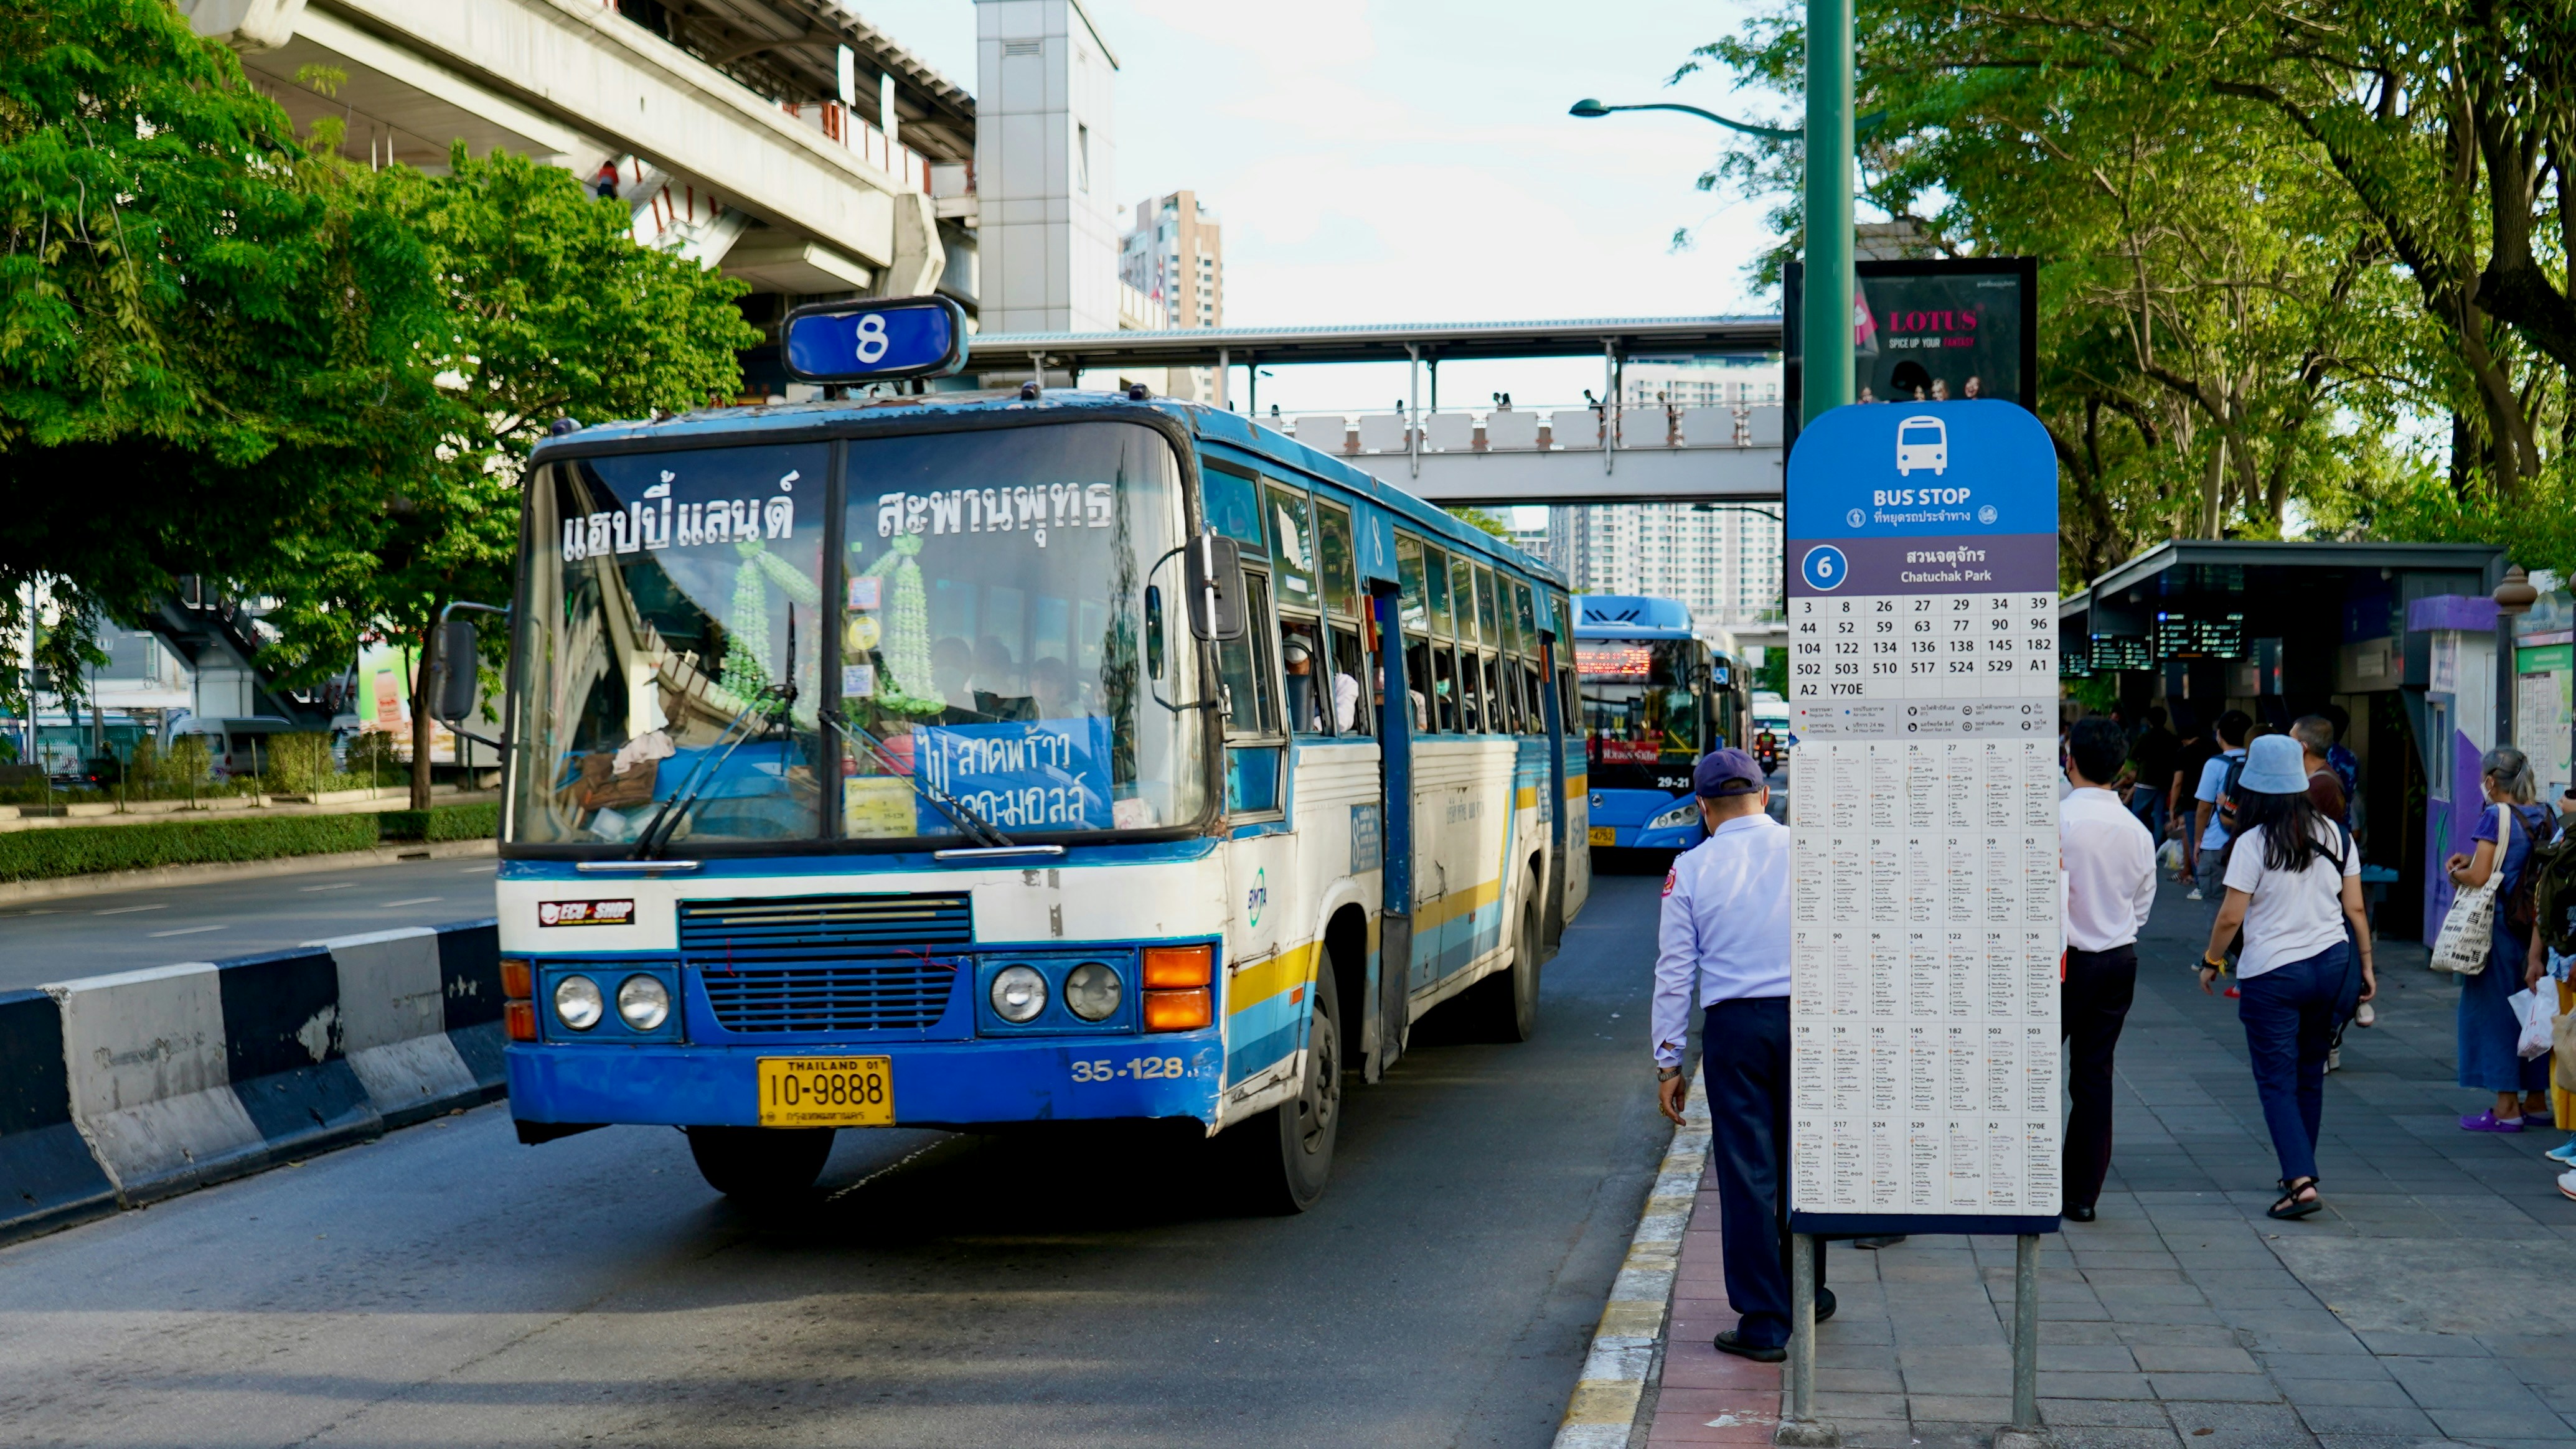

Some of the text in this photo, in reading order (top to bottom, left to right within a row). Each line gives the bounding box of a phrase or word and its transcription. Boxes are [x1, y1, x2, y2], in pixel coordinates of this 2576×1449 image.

[1890, 310, 1977, 332] LOTUS
[856, 314, 888, 363] 8
[1889, 337, 1909, 349] SPICE
[1909, 337, 1920, 348] UP
[1922, 337, 1941, 348] YOUR
[1874, 487, 1971, 507] BUS STOP
[878, 482, 1111, 548] สะพานพุทธ
[1874, 508, 1971, 527] ที่หยุดรถประจำทาง
[1371, 515, 1383, 567] 8
[1907, 545, 1986, 568] สวนจตุจักร
[1817, 555, 1833, 578] 6
[1901, 570, 1992, 583] Chatuchak Park
[1805, 598, 2047, 613] 3 8 26 27 29 34 39
[1800, 618, 2047, 634] 44 52 59 63 77 90 96
[1797, 639, 2051, 654] 104 122 134 136 138 145 182
[1620, 649, 1650, 674] 29
[1797, 664, 1821, 675] 502
[1835, 663, 1858, 675] 503
[1873, 662, 1897, 674] 510
[1911, 662, 1935, 673] 517
[1949, 661, 1974, 673] 524
[1988, 660, 2013, 672] 529
[2030, 659, 2046, 671] A1
[1800, 683, 1863, 695] A2 Y70E
[957, 724, 1070, 776] ลาดพร้าว
[1657, 776, 1690, 788] 29-21
[1248, 887, 1267, 909] BMTA
[593, 901, 633, 919] SHOP
[787, 1061, 878, 1071] THAILAND 01
[772, 1073, 883, 1105] 10-9888
